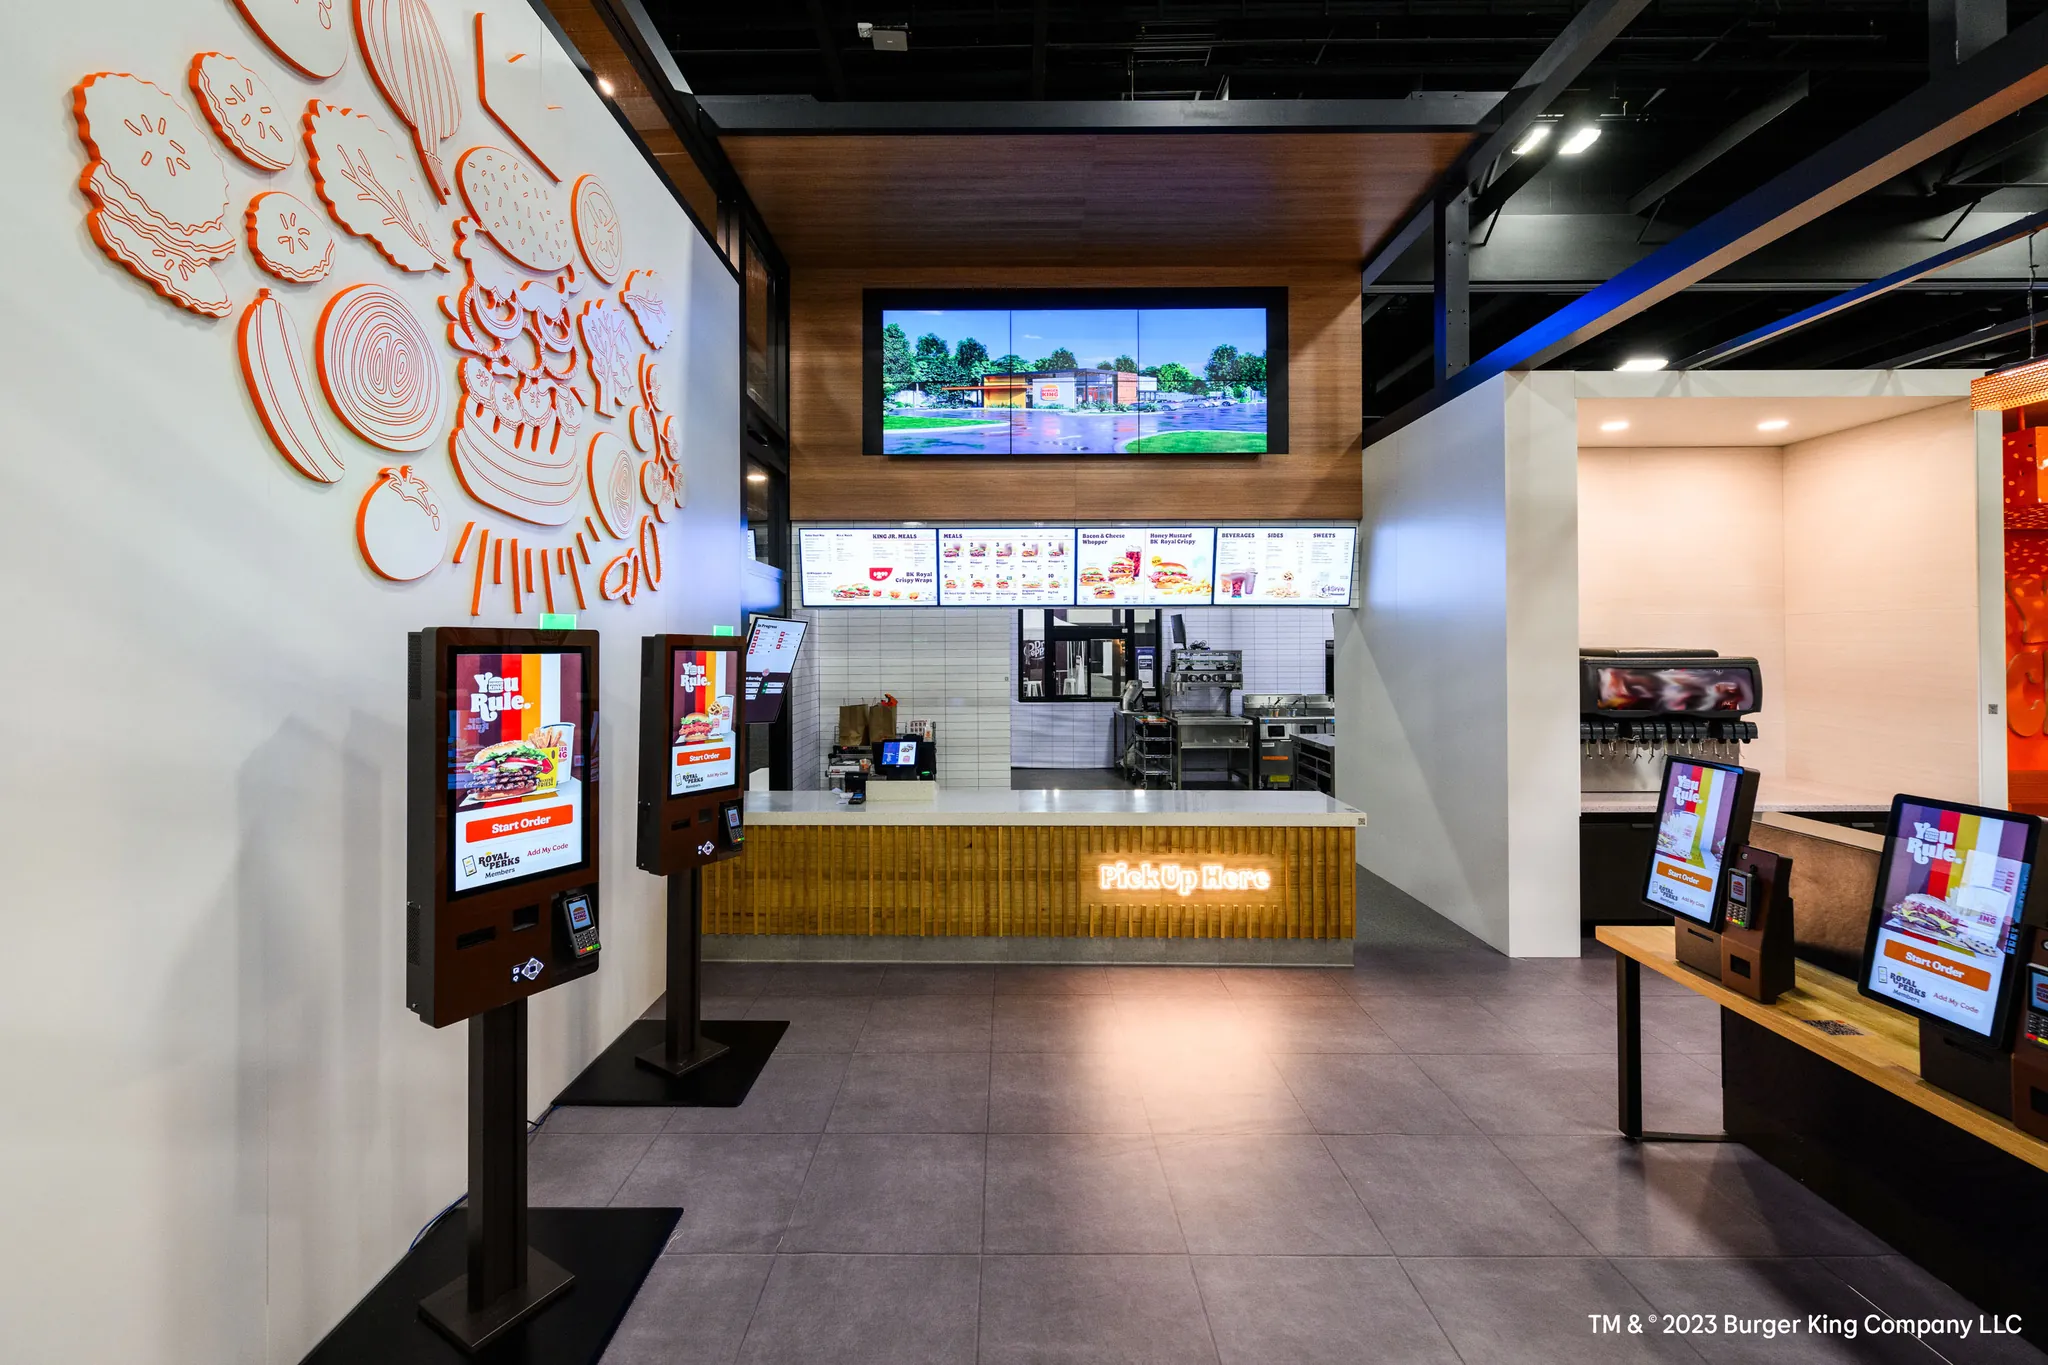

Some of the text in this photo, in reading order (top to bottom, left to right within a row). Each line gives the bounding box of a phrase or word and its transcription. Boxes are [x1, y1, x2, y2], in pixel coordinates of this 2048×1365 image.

[681, 661, 705, 675] You
[473, 672, 519, 693] You
[680, 675, 711, 692] Rule.
[470, 692, 532, 722] Rule.
[1677, 775, 1699, 790] You
[1672, 786, 1703, 806] Rule.
[491, 816, 551, 834] Start Order
[1913, 822, 1954, 845] You
[478, 852, 509, 868] ROYAL
[527, 849, 540, 857] Add
[552, 843, 569, 851] Code
[1906, 837, 1963, 865] Rule.
[489, 856, 520, 870] PERKS
[485, 867, 515, 879] Members
[1200, 863, 1271, 890] Here
[1668, 869, 1700, 884] Start Order
[1979, 914, 1996, 924] ING
[1905, 951, 1965, 979] Start Order
[1890, 972, 1917, 988] ROYAL
[1898, 982, 1979, 1014] PERKS Add My Code
